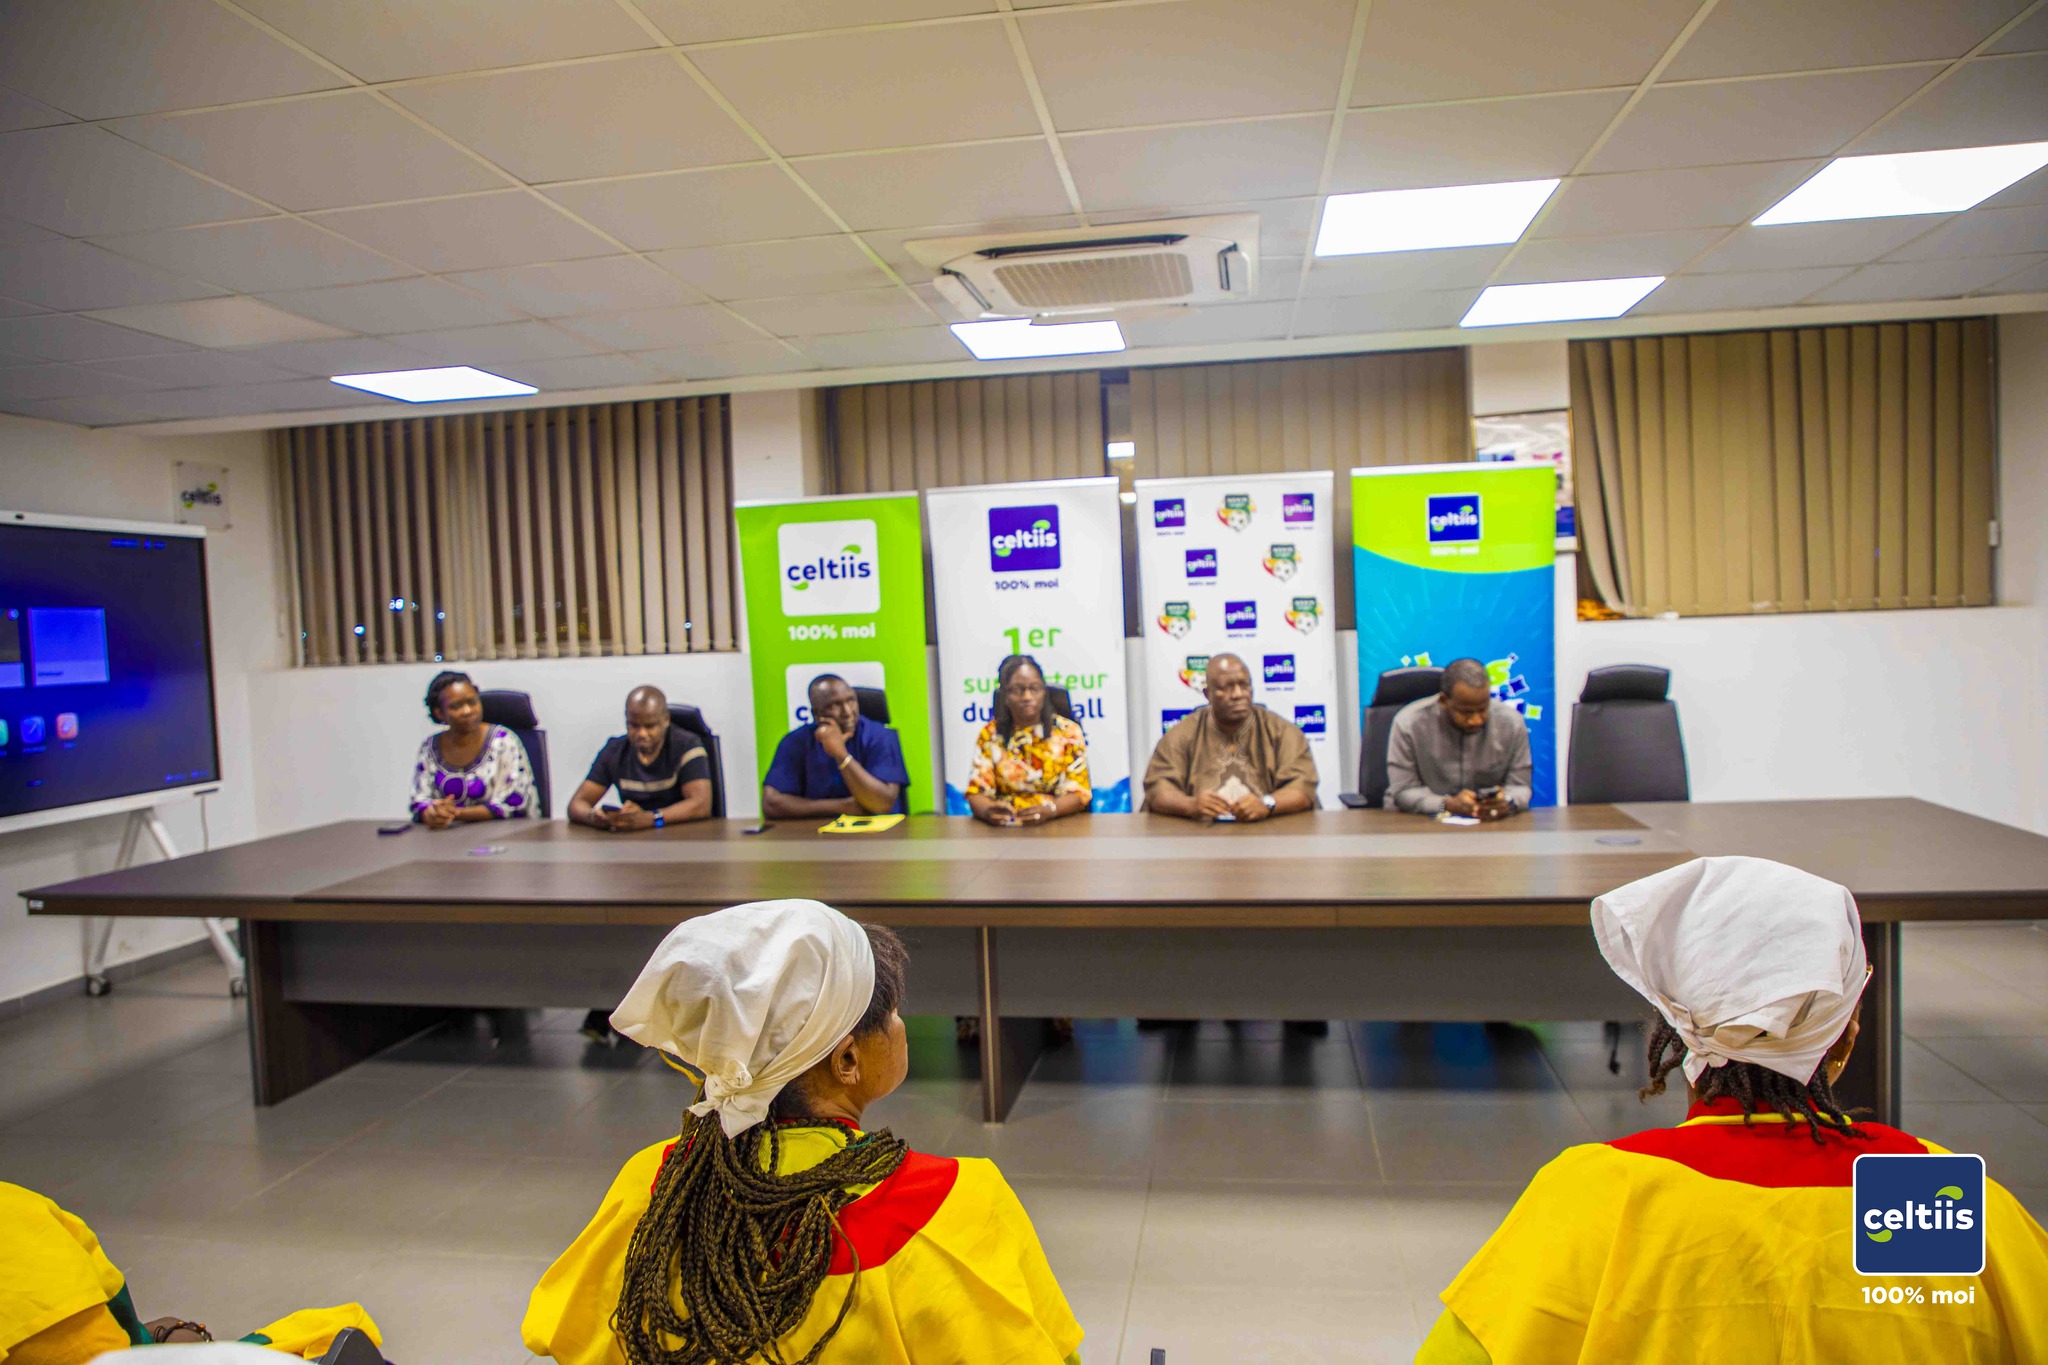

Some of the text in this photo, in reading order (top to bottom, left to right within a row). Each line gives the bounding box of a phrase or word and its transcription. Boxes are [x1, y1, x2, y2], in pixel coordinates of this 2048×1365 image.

[991, 528, 1058, 550] celtiis
[787, 556, 871, 581] celtiis
[994, 577, 1059, 591] 100% moi
[788, 622, 876, 641] 100% moi
